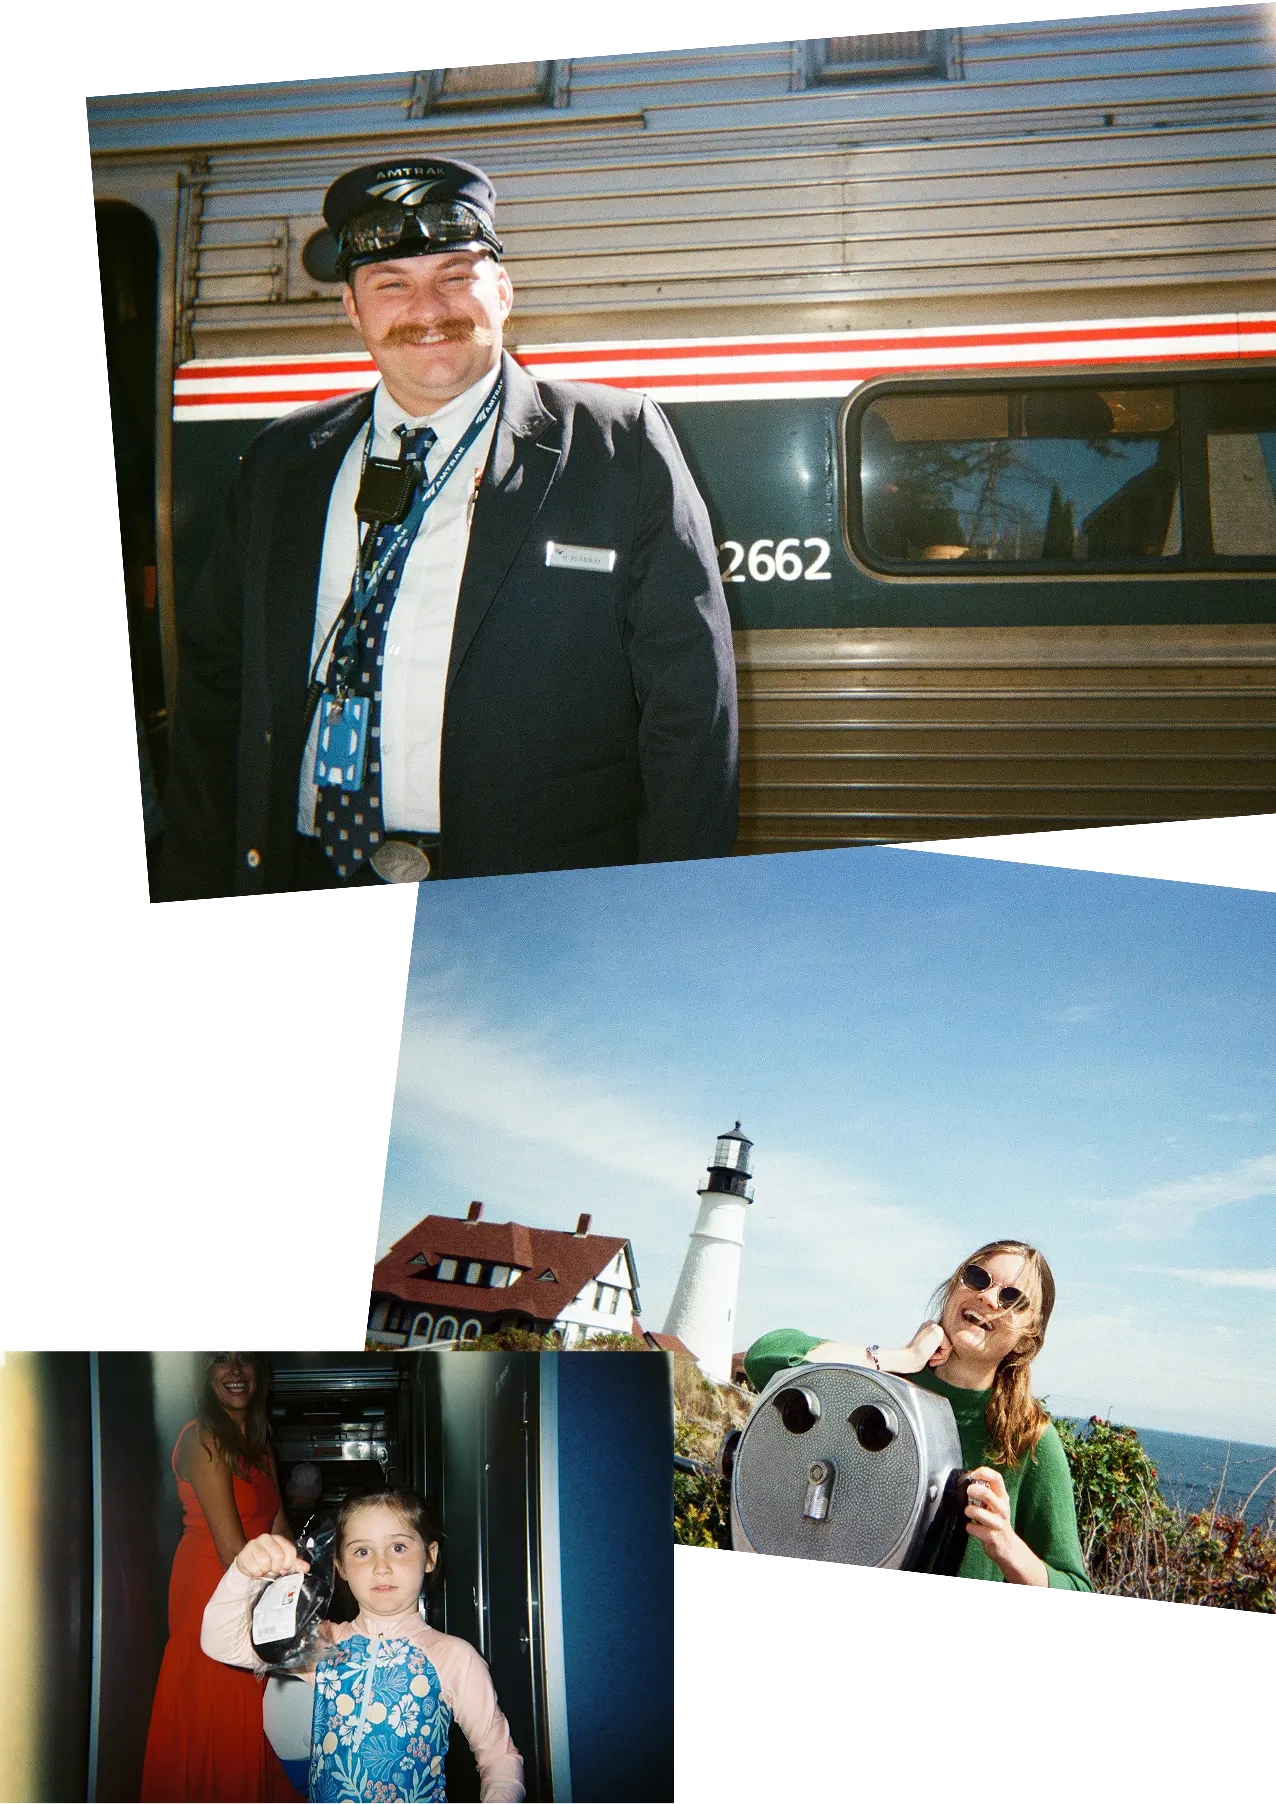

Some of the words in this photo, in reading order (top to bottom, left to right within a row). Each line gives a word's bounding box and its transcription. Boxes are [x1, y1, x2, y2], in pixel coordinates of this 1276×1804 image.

[376, 167, 445, 180] AMTRAK
[436, 446, 465, 488] AMTRAK
[377, 529, 408, 576] AMTRAK
[715, 537, 832, 582] 2662
